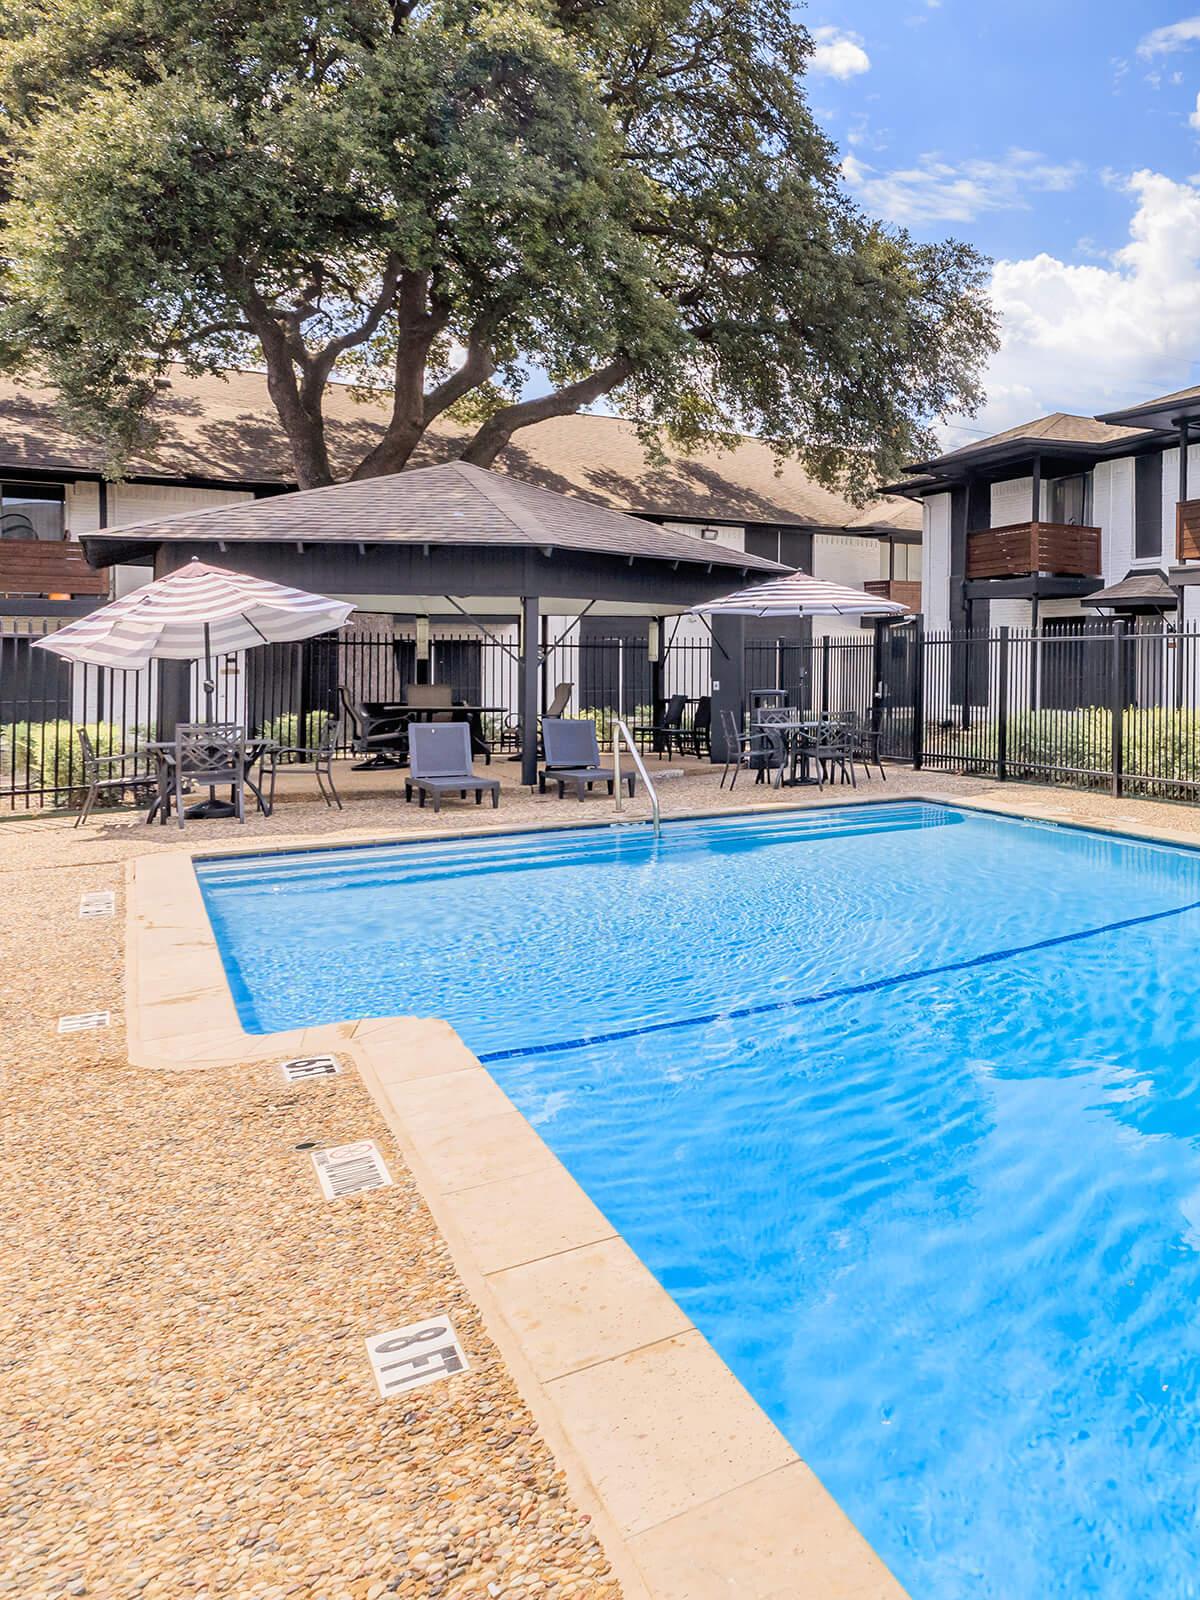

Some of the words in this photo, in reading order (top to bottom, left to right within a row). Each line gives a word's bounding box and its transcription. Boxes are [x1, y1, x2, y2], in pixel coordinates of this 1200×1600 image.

[286, 1058, 332, 1069] 6
[289, 1064, 336, 1080] FT
[375, 1326, 447, 1353] 8
[380, 1345, 463, 1389] FT
